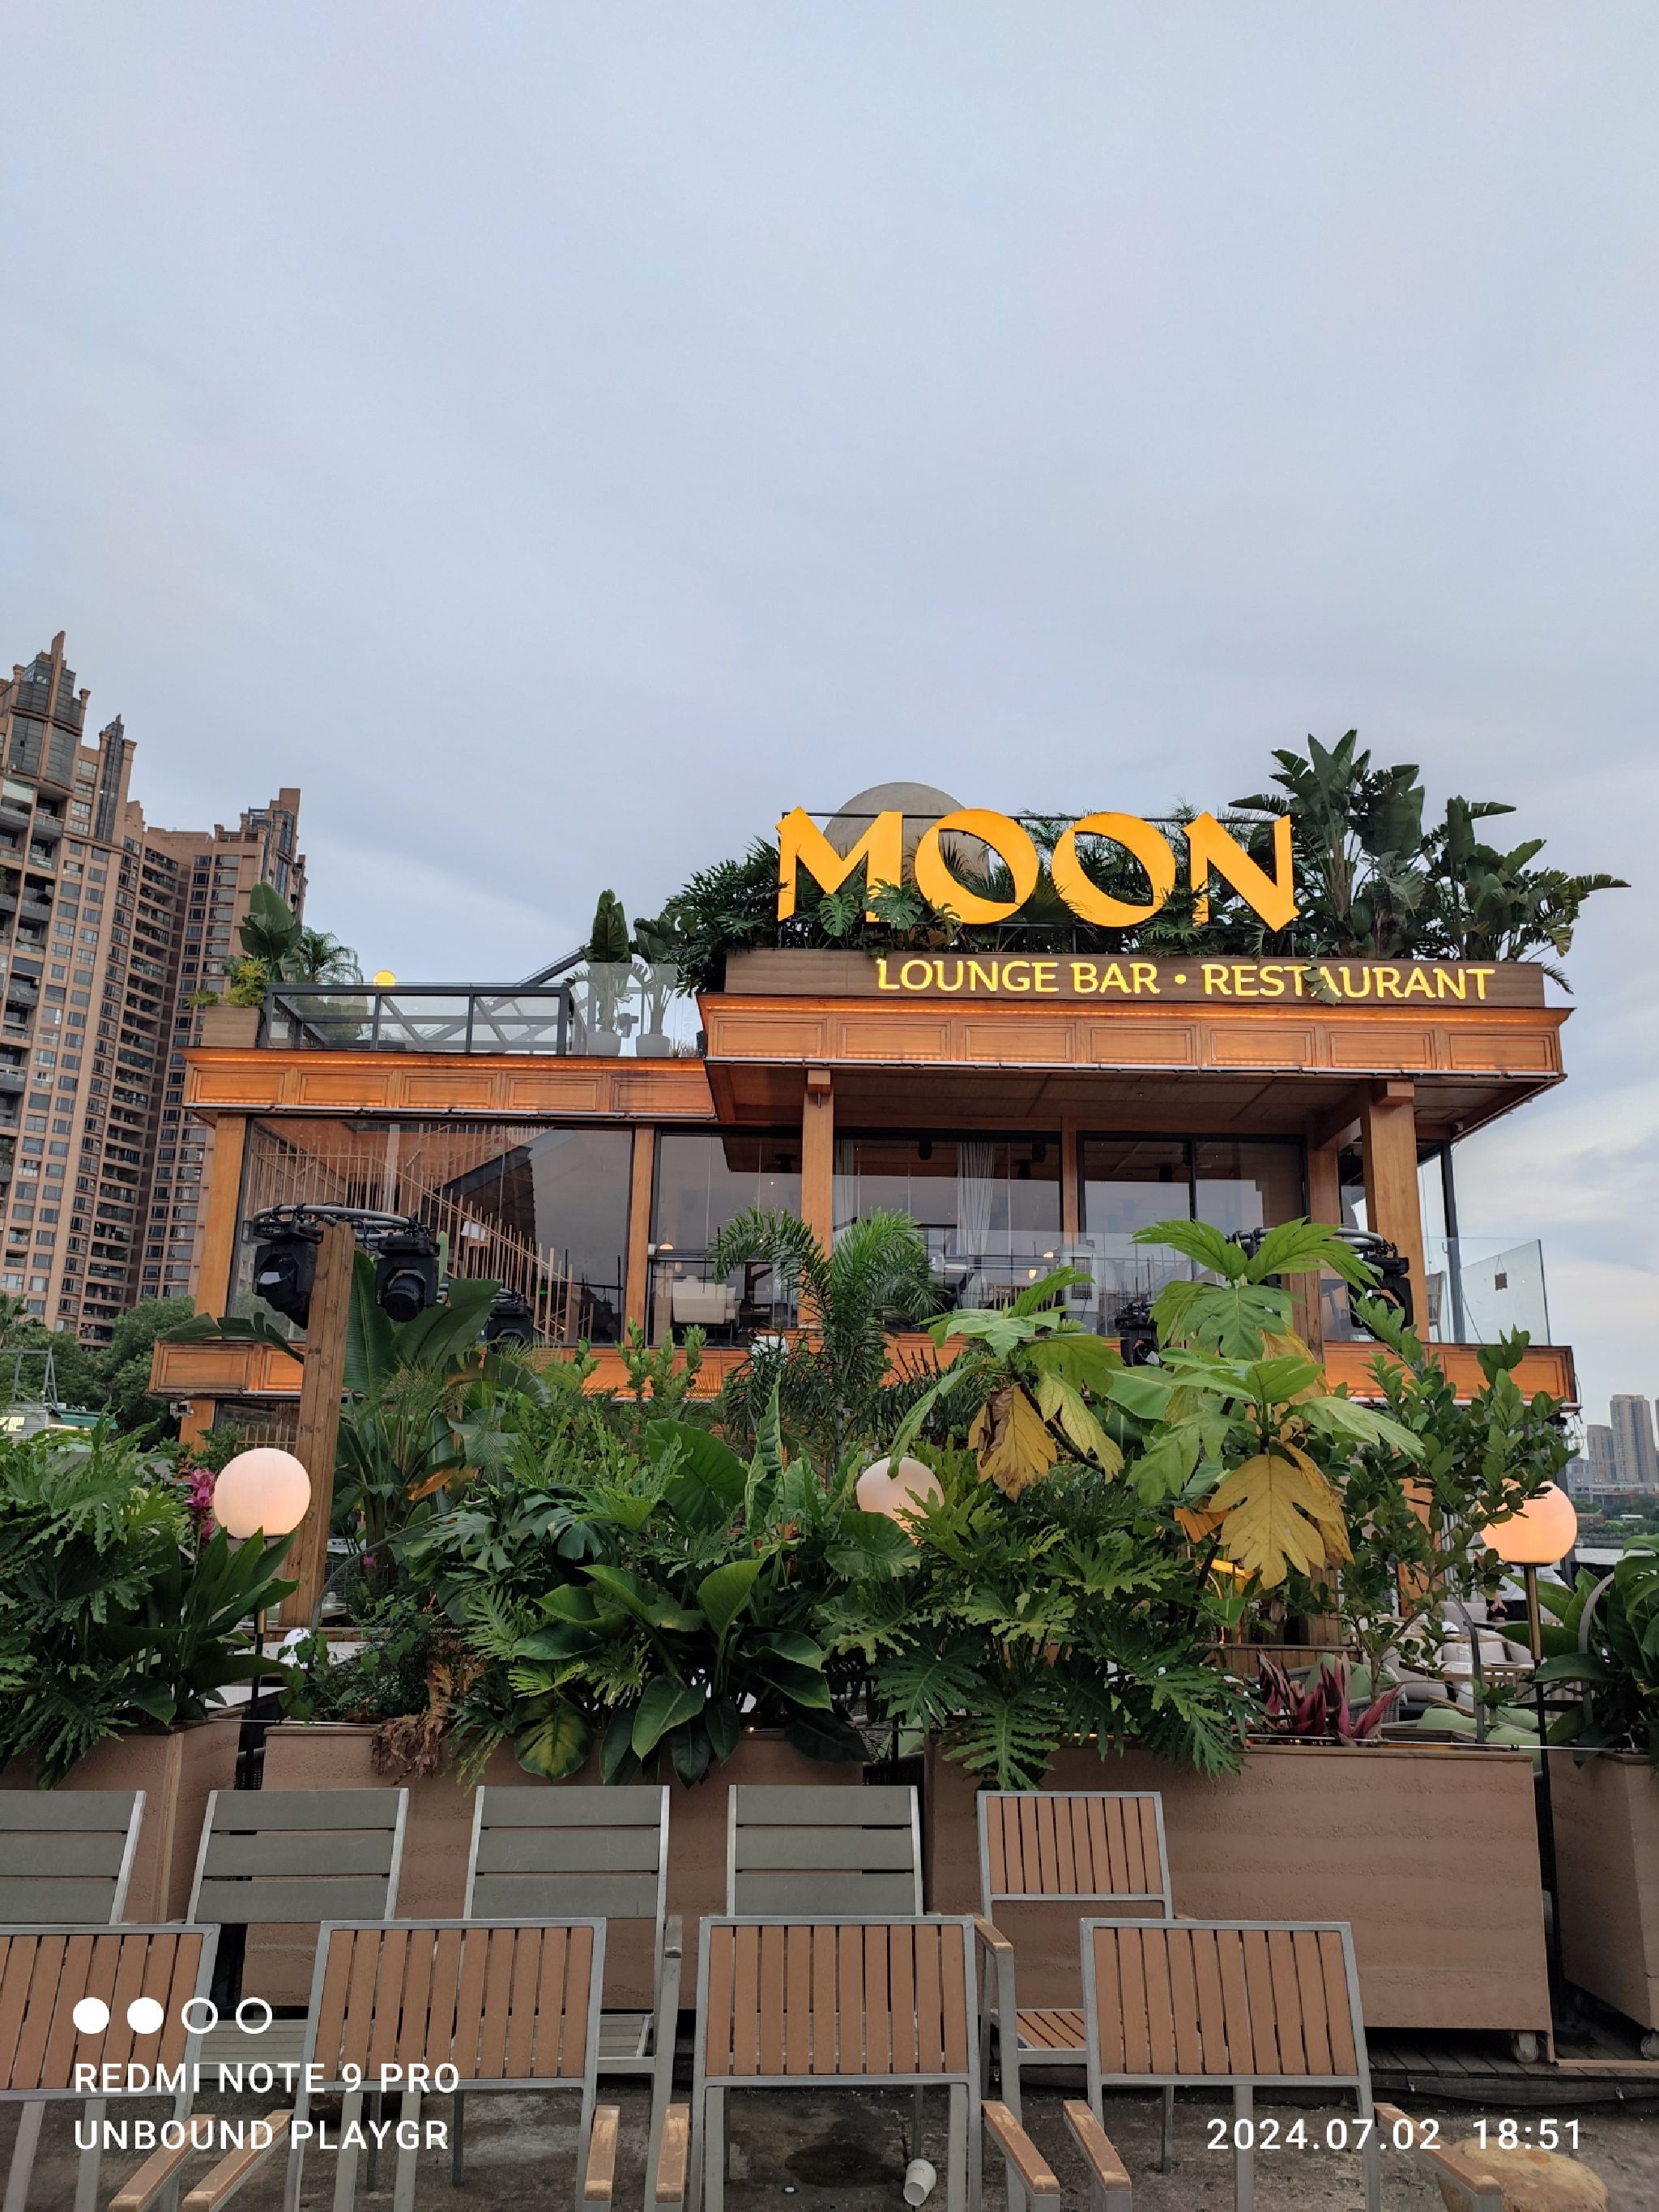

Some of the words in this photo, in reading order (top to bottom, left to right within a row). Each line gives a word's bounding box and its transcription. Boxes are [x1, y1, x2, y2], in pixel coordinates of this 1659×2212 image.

[776, 806, 1300, 931] MOON
[876, 959, 1060, 993] LOUNGE
[1068, 963, 1161, 994] BAR
